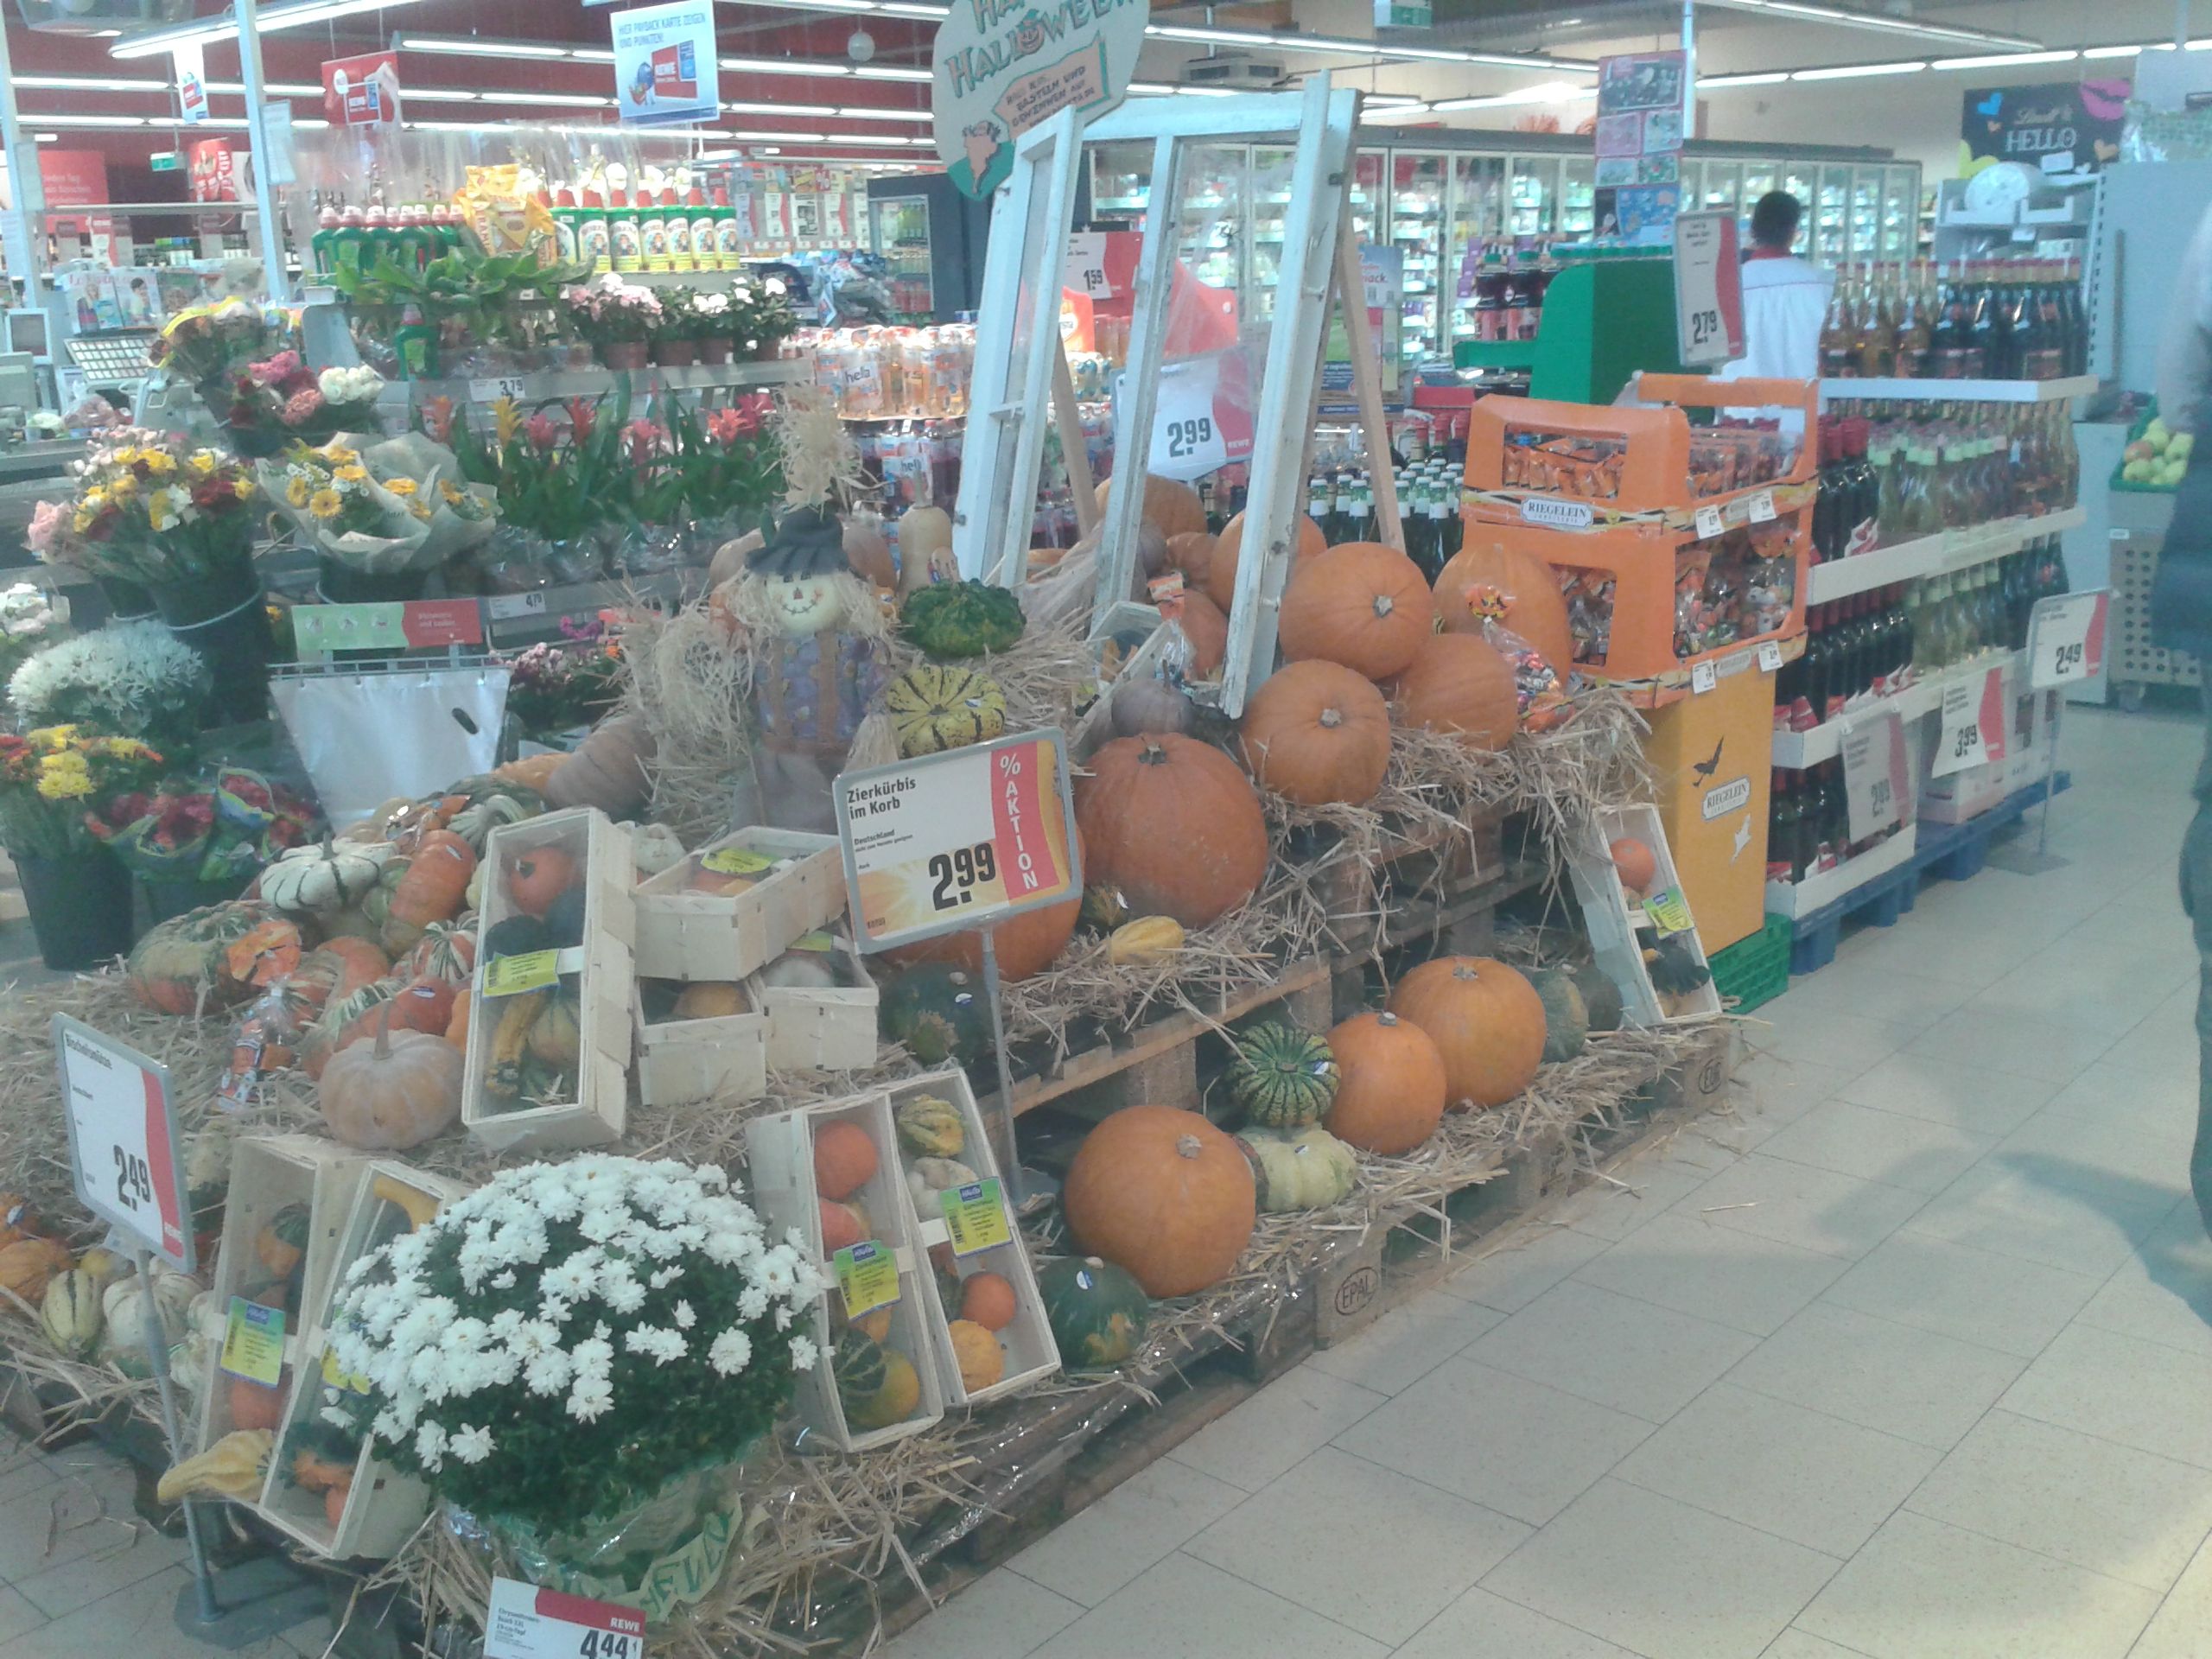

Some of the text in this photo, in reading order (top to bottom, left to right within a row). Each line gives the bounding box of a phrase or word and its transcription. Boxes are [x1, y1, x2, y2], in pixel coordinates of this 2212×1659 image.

[944, 0, 1135, 99] HALLOWEE
[2005, 127, 2077, 152] HELLO
[1083, 269, 1103, 291] 1.59
[1692, 311, 1718, 345] 2.79
[1168, 417, 1211, 458] 2.99
[1528, 501, 1586, 518] RIEGELEIN
[2056, 643, 2082, 674] 2.49
[1955, 724, 1978, 758] 3.99
[847, 777, 917, 804] Zierkürbis
[1707, 783, 1746, 810] RIEGELEIN
[849, 796, 900, 819] im Korb
[854, 830, 895, 846] Deutschland
[1005, 780, 1039, 890] AKTION
[928, 842, 996, 912] 2.99
[113, 1144, 151, 1211] 2.49
[1342, 1274, 1372, 1309] EPAL
[609, 1617, 640, 1632] REWE
